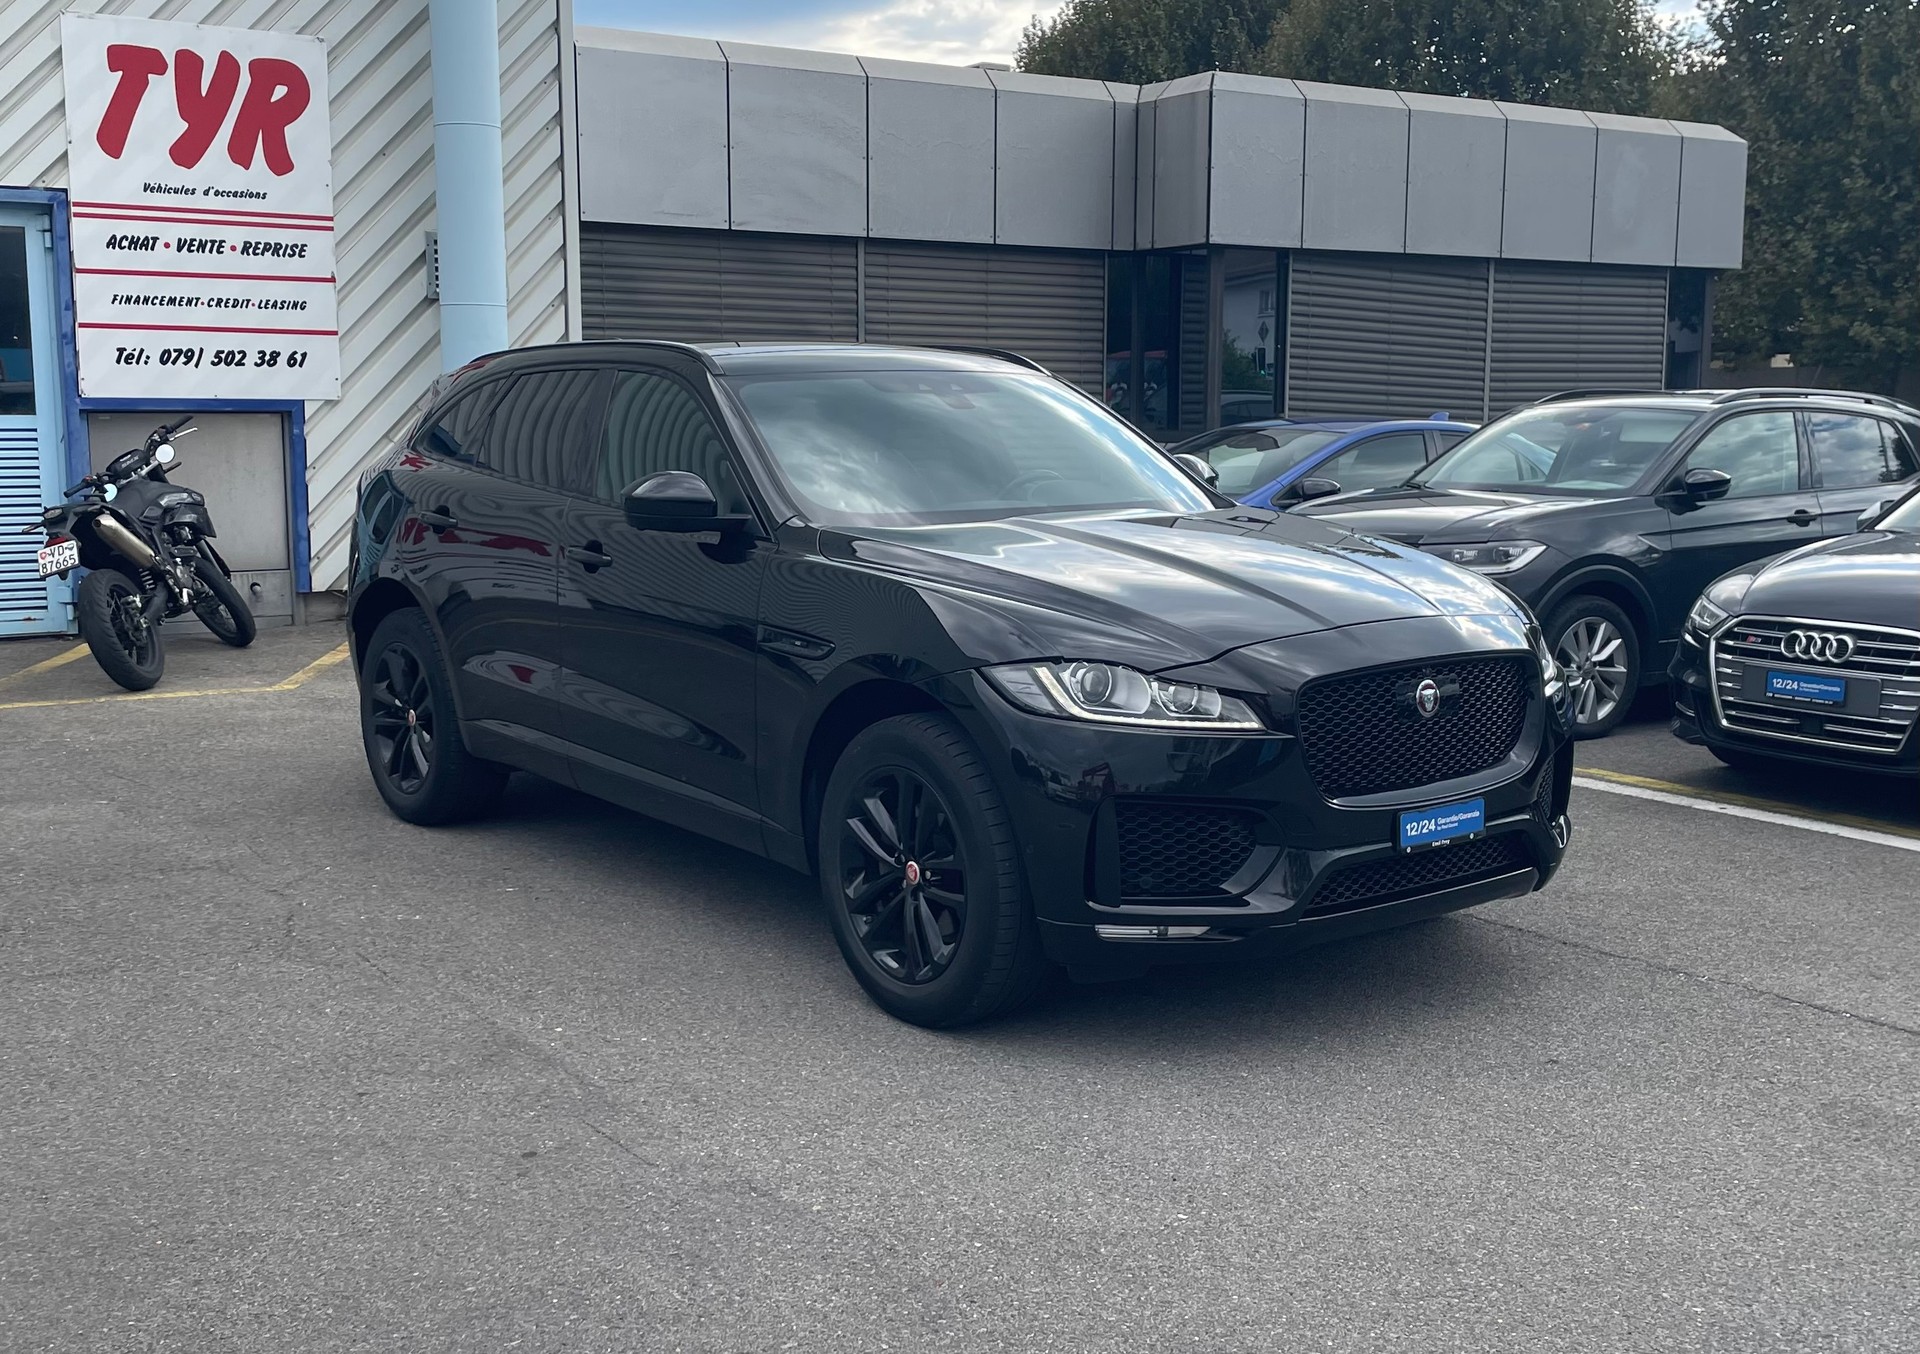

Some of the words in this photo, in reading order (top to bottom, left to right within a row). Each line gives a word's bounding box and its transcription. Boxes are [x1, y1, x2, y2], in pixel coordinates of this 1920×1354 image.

[96, 44, 311, 177] TYR
[143, 182, 197, 197] Véhicules
[203, 185, 268, 201] d'occasions
[106, 234, 160, 252] ACHAT
[176, 237, 226, 255] VENTE
[240, 240, 308, 259] REPRISE
[111, 294, 201, 308] FINANCEMENT
[207, 297, 252, 310] CREDIT
[258, 299, 307, 312] LEASING
[115, 347, 151, 366] Tél:
[210, 349, 248, 368] 502
[254, 350, 281, 368] 38
[286, 350, 308, 368] 61
[50, 545, 65, 558] VD
[41, 554, 76, 574] 87665
[1772, 678, 1798, 690] 12/24
[1406, 818, 1435, 836] 12/24
